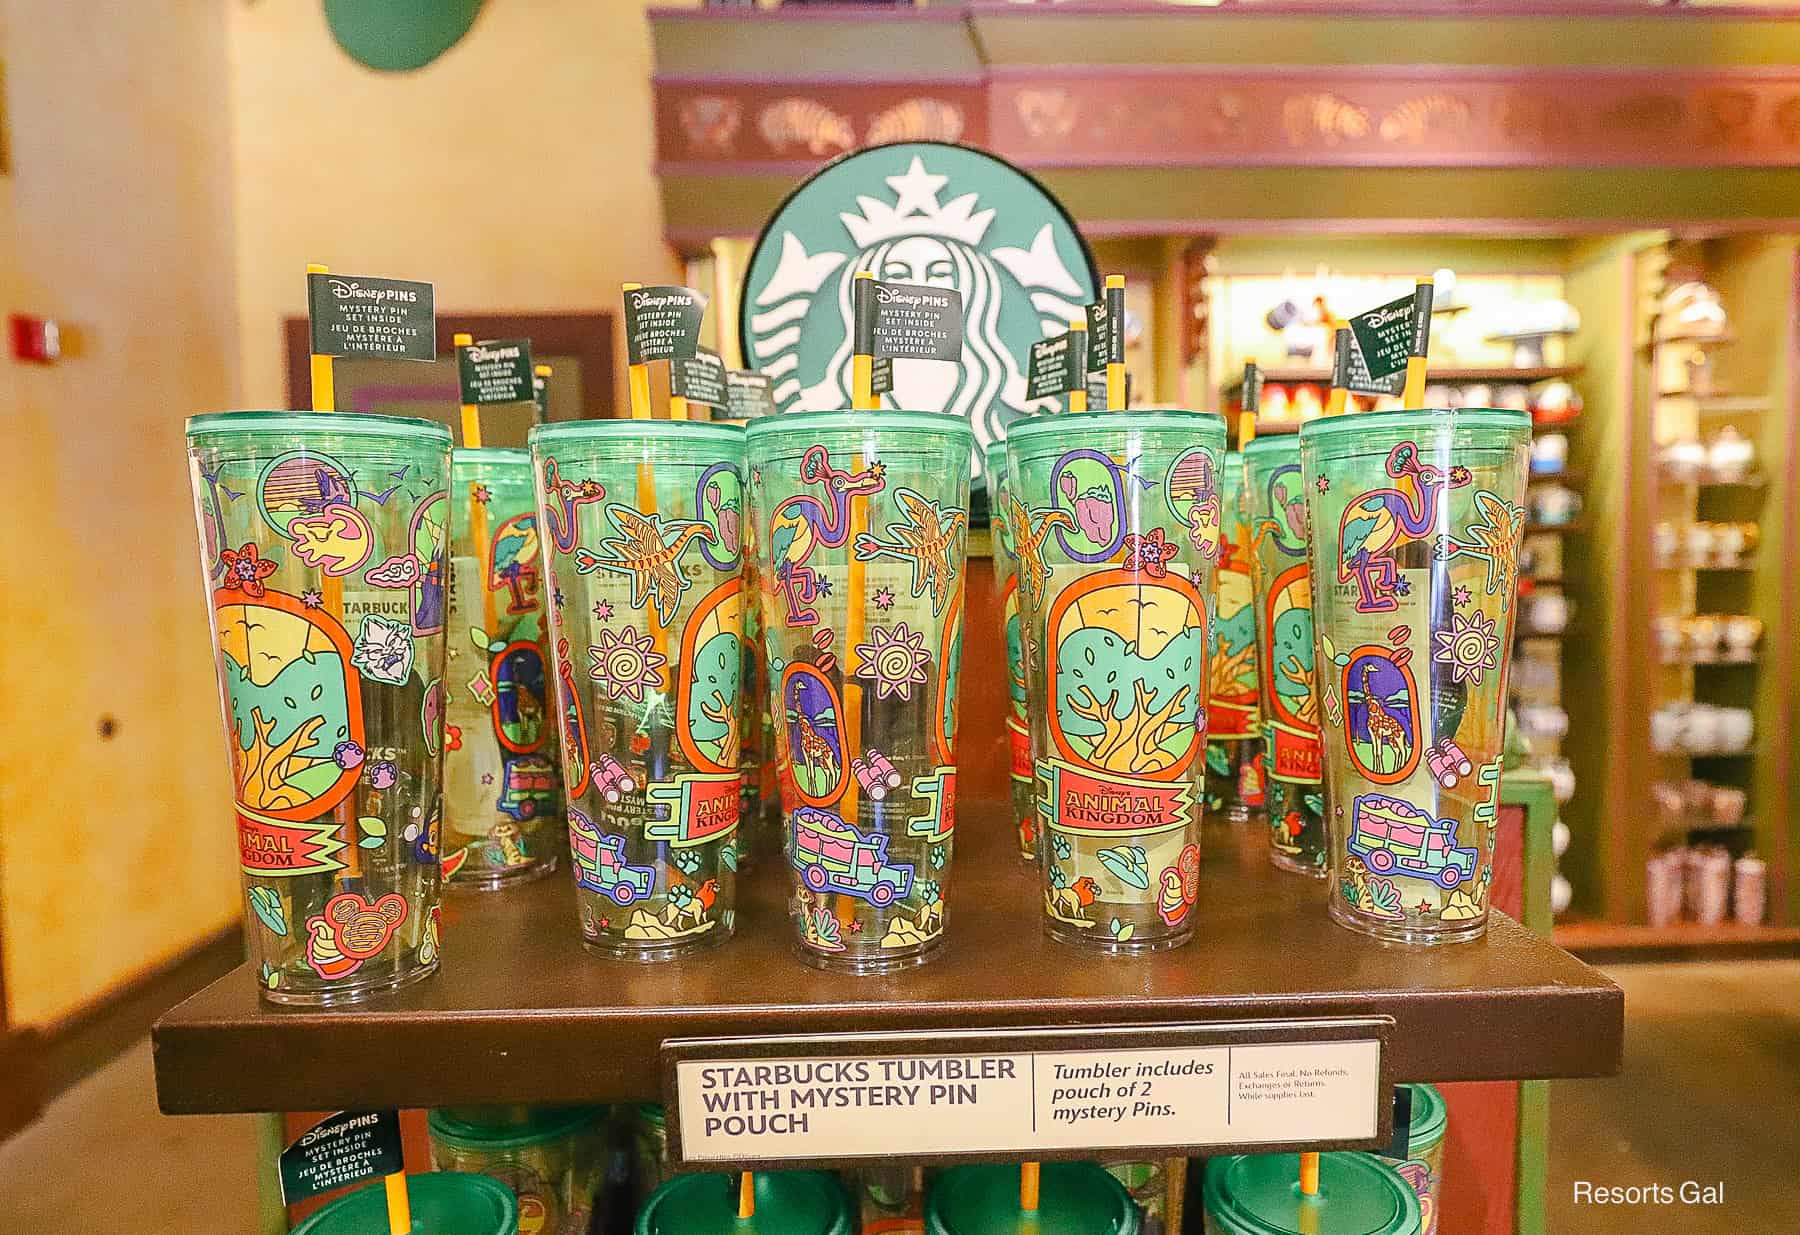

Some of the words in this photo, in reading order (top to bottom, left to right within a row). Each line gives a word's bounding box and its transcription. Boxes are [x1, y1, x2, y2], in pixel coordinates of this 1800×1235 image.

[328, 280, 386, 304] Disney
[387, 290, 416, 302] PINS
[667, 296, 692, 306] PINS
[875, 286, 922, 310] Disney
[922, 296, 948, 308] PINS
[340, 305, 386, 314] MYSTERY
[390, 307, 408, 316] PIN
[368, 315, 402, 324] INSIDE
[880, 310, 921, 318] MYSTERY
[925, 312, 940, 320] PIN
[331, 324, 349, 332] JEU
[369, 326, 416, 336] BROCHES
[873, 328, 888, 336] JEU
[906, 330, 948, 338] BROCHES
[904, 320, 934, 328] INSIDE
[1378, 320, 1412, 338] MYSTER
[343, 602, 408, 614] TARBUCK
[1066, 790, 1164, 812] ANIMAL
[1066, 806, 1163, 824] KINGDOM
[242, 831, 294, 854] IMAL
[243, 849, 294, 866] GDOM
[702, 1062, 870, 1088] STARBUCKS
[878, 1059, 1016, 1082] TUMBLER
[1053, 1062, 1131, 1080] Tumbler
[1136, 1060, 1214, 1077] includes
[1239, 1071, 1250, 1079] All
[1253, 1070, 1274, 1078] Sales
[1299, 1069, 1312, 1077] No
[1052, 1082, 1110, 1104] pouch
[1116, 1081, 1138, 1098] of
[1140, 1082, 1152, 1097] 2
[1239, 1081, 1280, 1090] Exchanges
[702, 1090, 779, 1112] WITH
[791, 1085, 920, 1109] MYSTERY
[930, 1084, 978, 1105] PIN
[1238, 1092, 1262, 1100] While
[1265, 1091, 1297, 1100] supplies
[1053, 1104, 1126, 1124] mystery
[1132, 1102, 1176, 1118] Pins.
[298, 1124, 348, 1146] Disney
[349, 1114, 378, 1129] PINS
[705, 1113, 808, 1137] POUCH
[305, 1137, 350, 1158] MYSTERY
[354, 1131, 372, 1142] PIN
[312, 1151, 330, 1163] SET
[333, 1140, 368, 1156] INSIDE
[298, 1166, 316, 1178] JEU
[320, 1161, 334, 1171] DE
[336, 1148, 382, 1166] BROCHES
